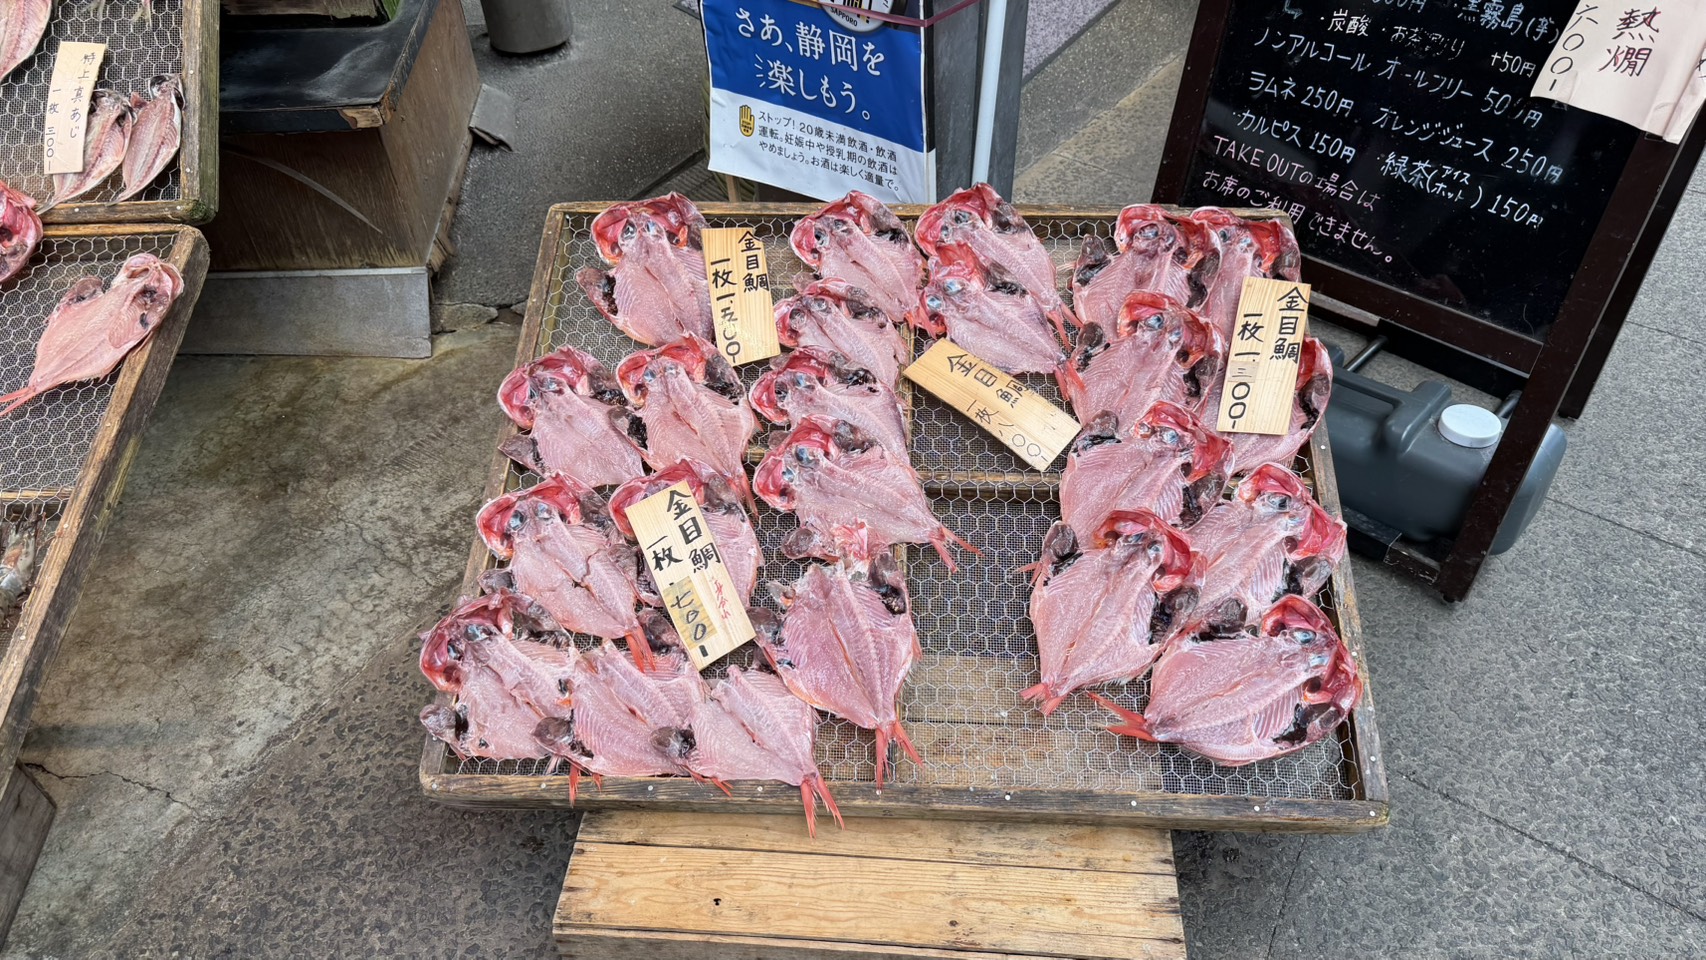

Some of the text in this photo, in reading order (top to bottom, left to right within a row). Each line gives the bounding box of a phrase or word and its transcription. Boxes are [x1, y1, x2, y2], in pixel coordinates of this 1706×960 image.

[735, 7, 885, 76] さあ、静岡を
[830, 6, 858, 27] SAPPORO
[767, 59, 871, 121] 楽しもう。
[1254, 27, 1371, 73] ノンアルコール
[1378, 57, 1473, 100] オールフリー
[1490, 51, 1536, 78] +50円
[759, 125, 898, 176] 運転。妊娠中や授乳期の飲酒は
[1214, 135, 1264, 168] TAKE
[1249, 71, 1563, 184] ラムネ 250円 オレンジジュース 250円
[759, 141, 900, 191] やめましょう。お酒は楽しく適量で。
[1309, 132, 1356, 164] 150円
[1487, 195, 1543, 229] 150円
[738, 230, 769, 293] 金目鯛
[1270, 286, 1308, 364] 金目鯛
[947, 353, 1029, 408] 金目鯛
[666, 489, 721, 574] 金目鯛
